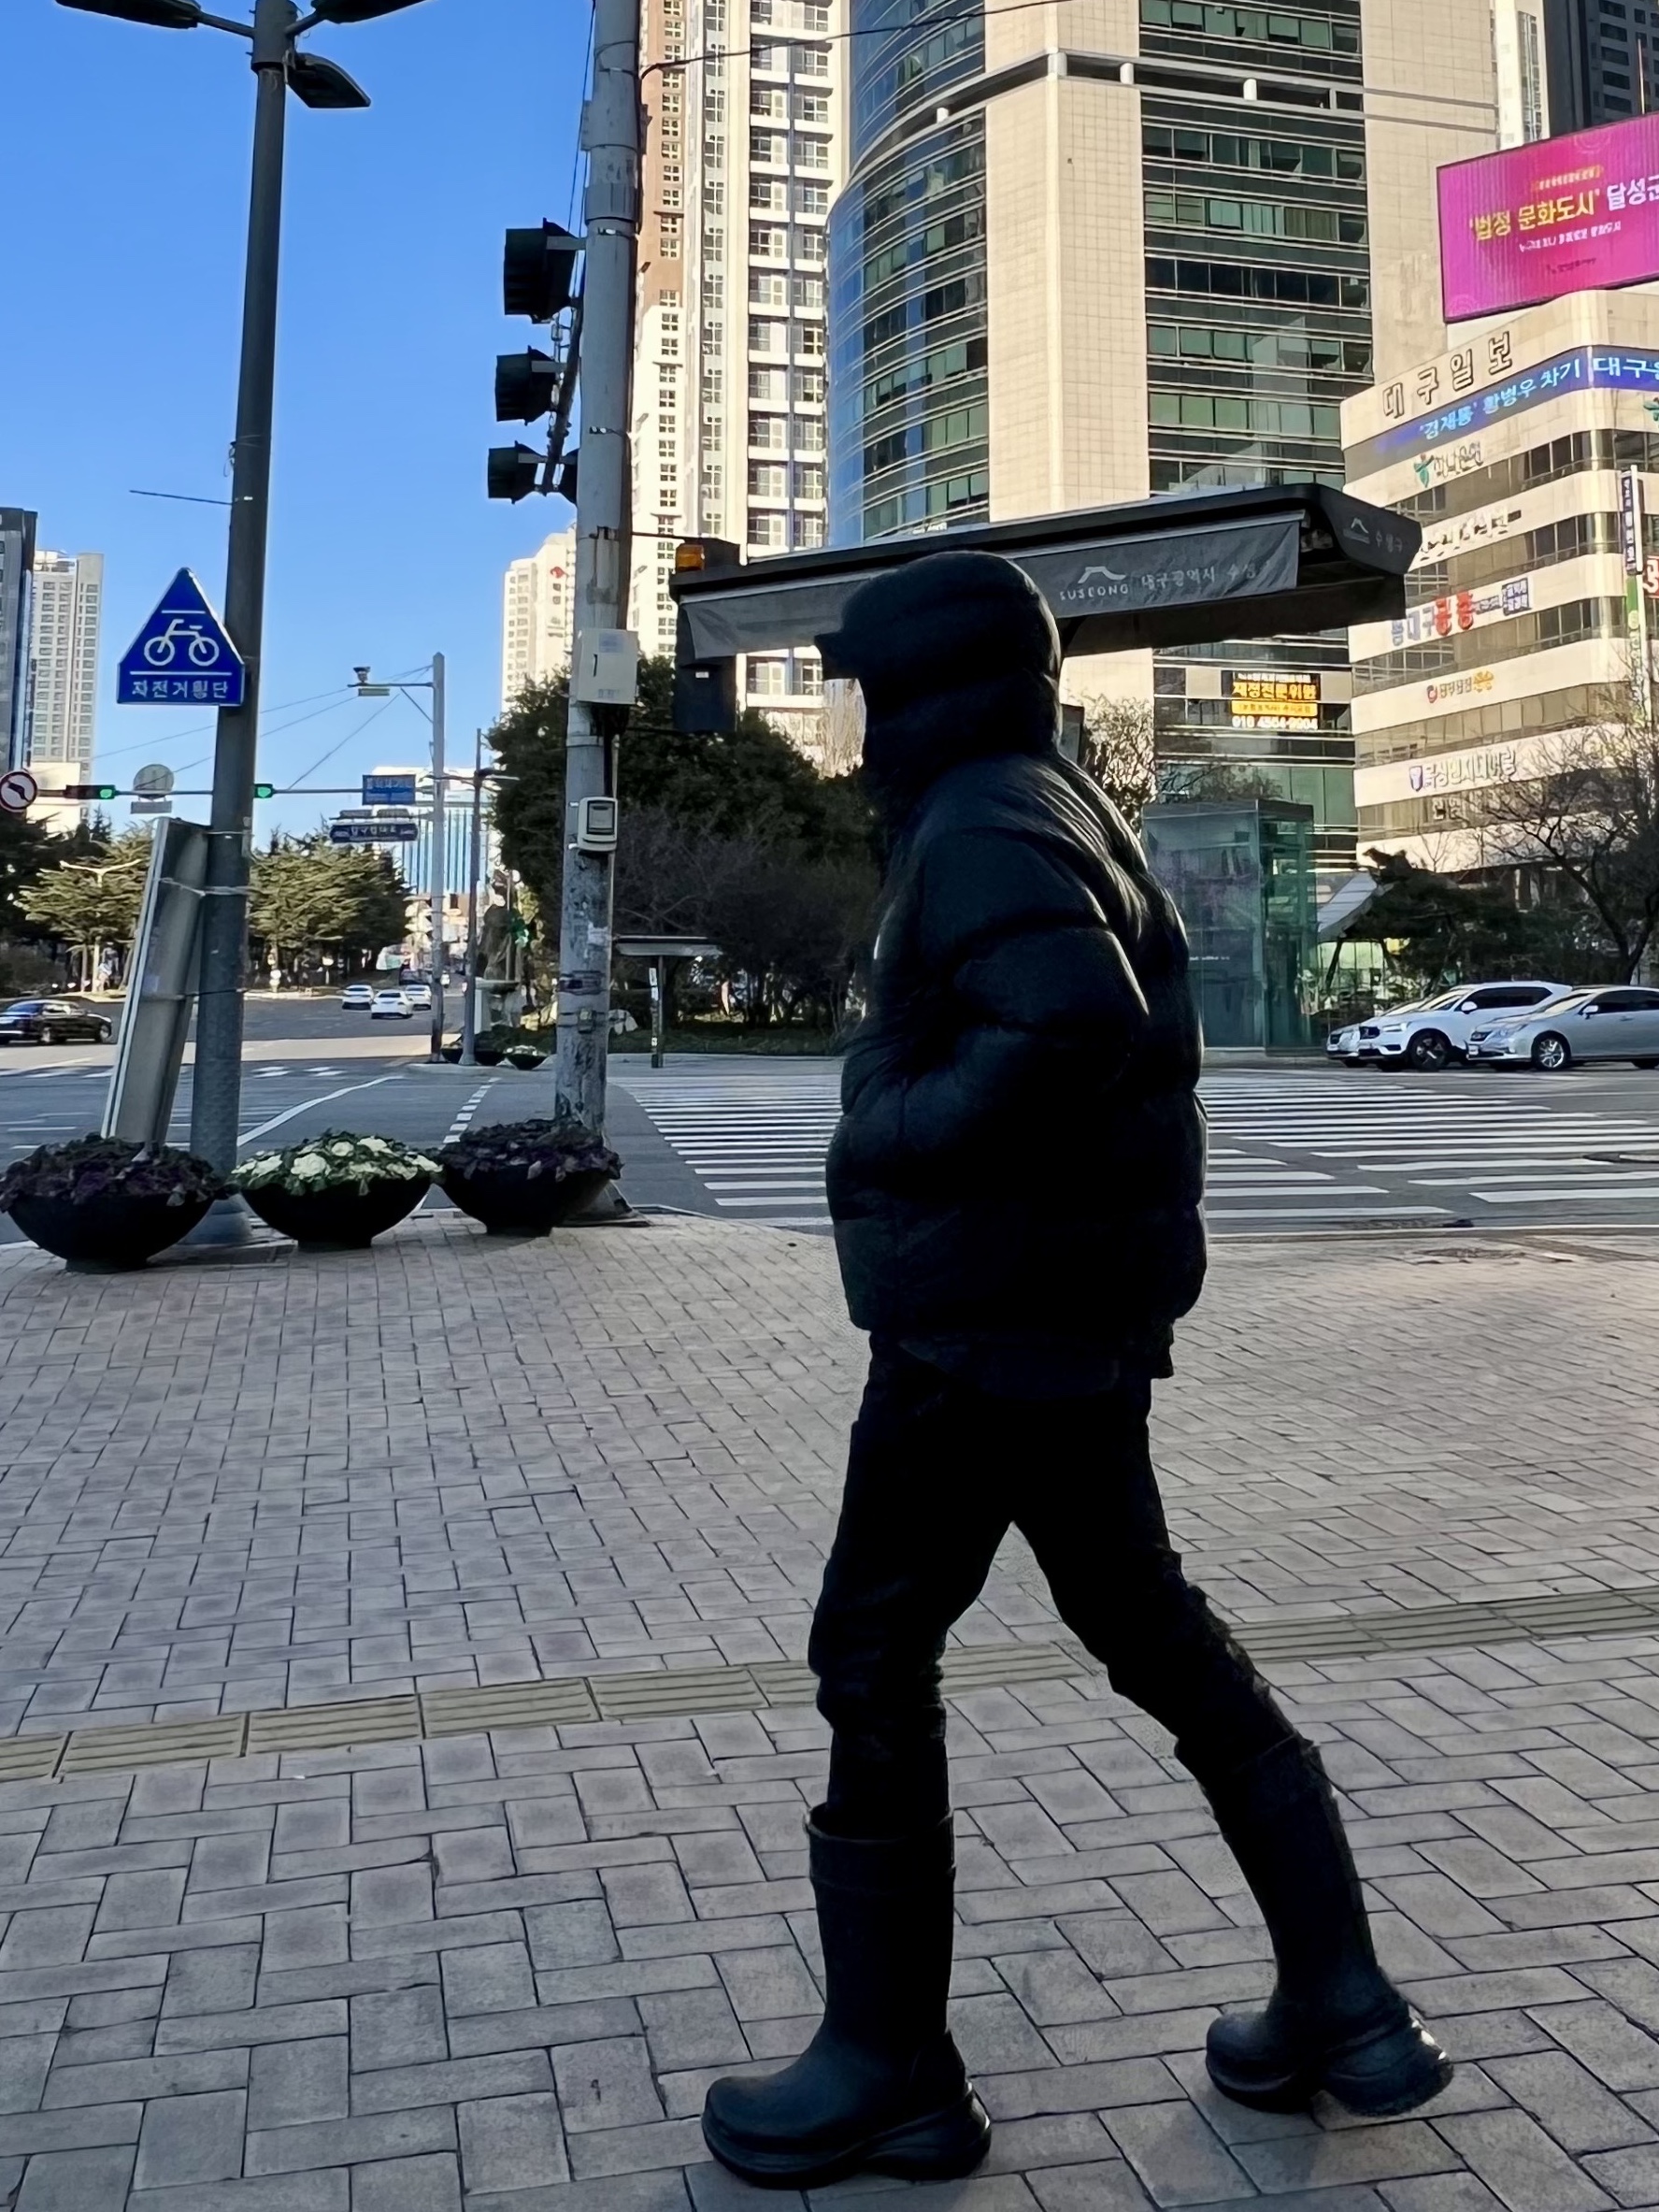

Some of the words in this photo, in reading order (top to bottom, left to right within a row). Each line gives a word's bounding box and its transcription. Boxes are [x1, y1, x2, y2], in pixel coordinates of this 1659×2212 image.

[1382, 330, 1513, 419] 대구일보
[1592, 356, 1659, 380] 대구
[132, 679, 229, 700] 자전거횡단
